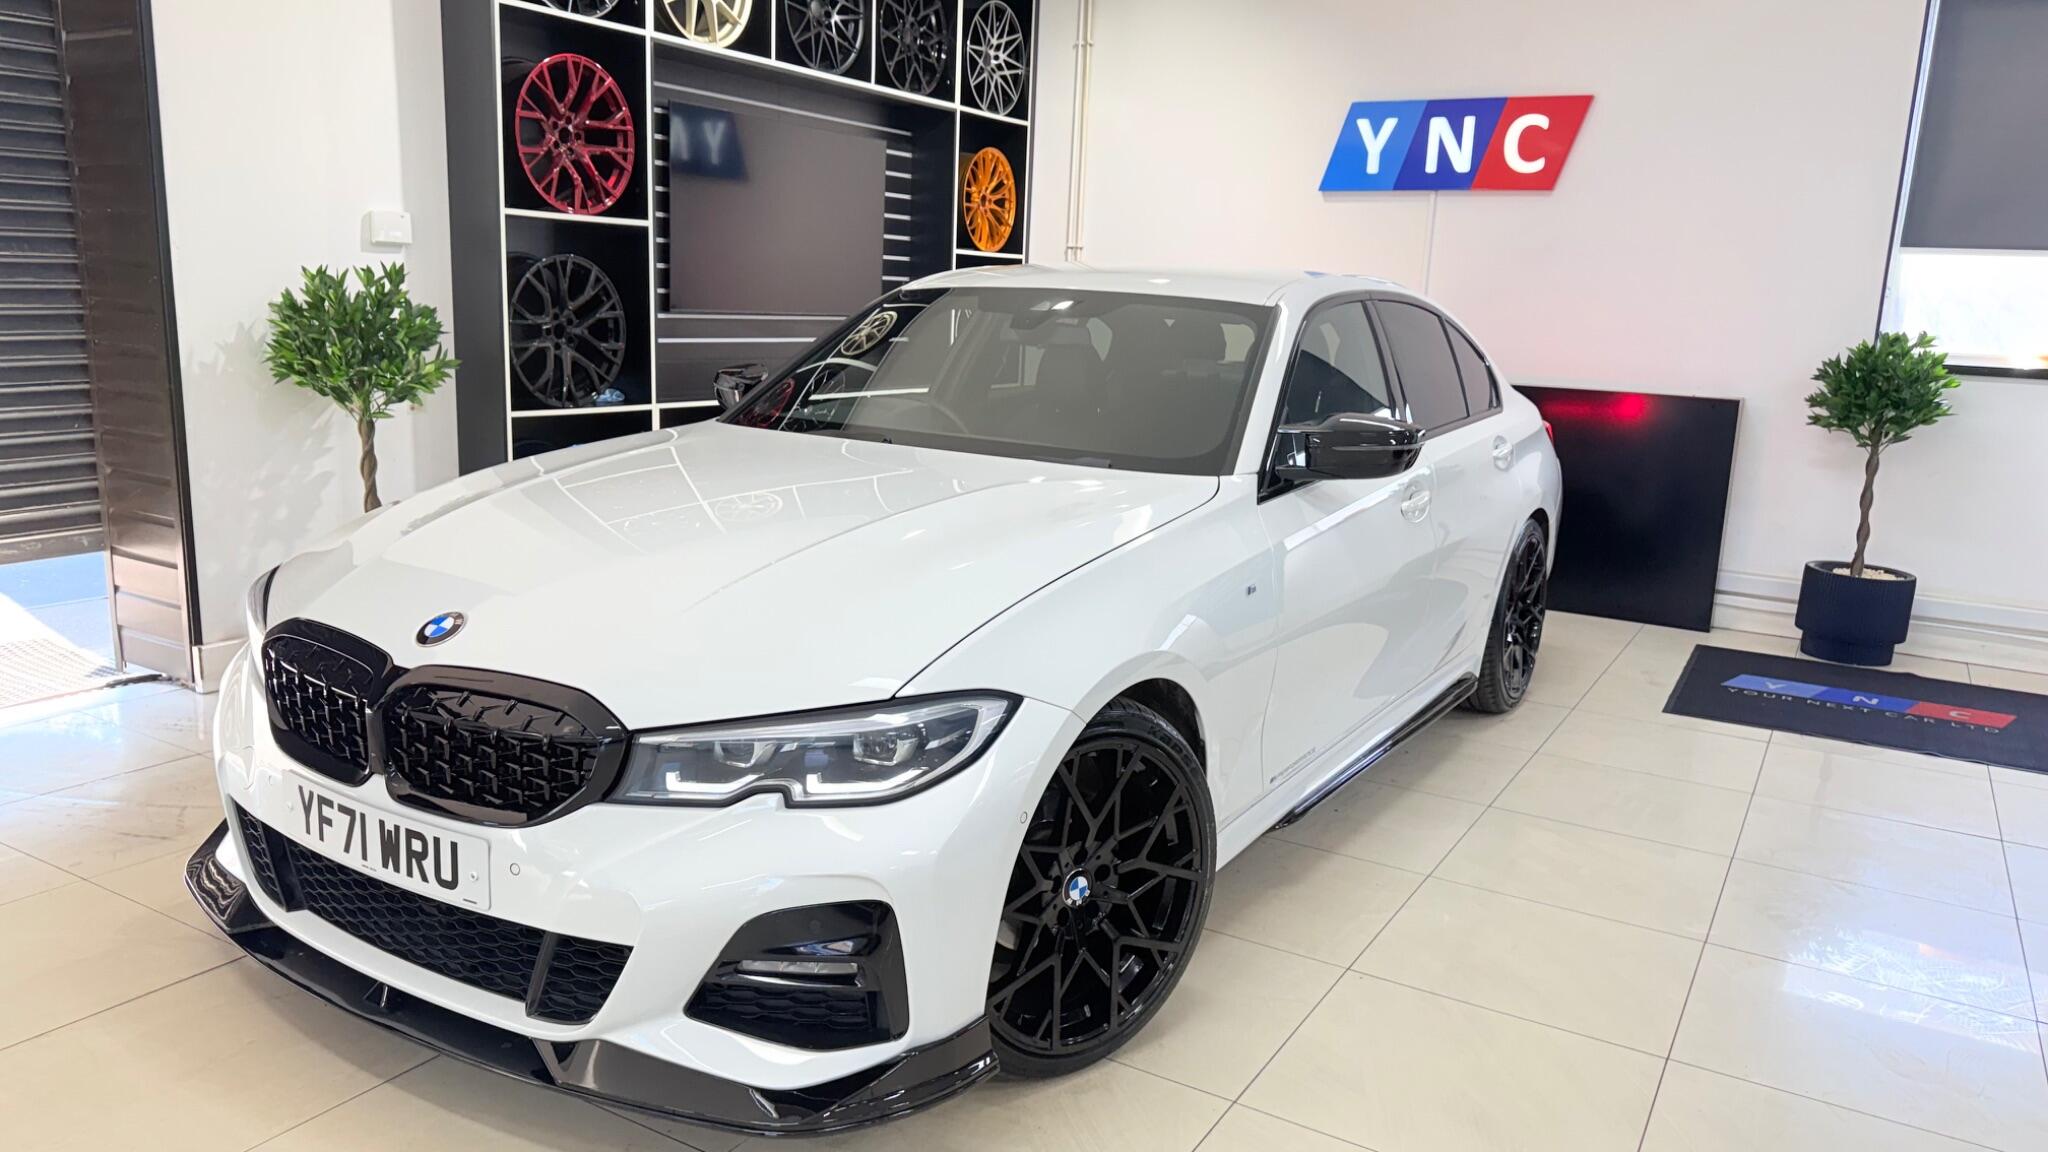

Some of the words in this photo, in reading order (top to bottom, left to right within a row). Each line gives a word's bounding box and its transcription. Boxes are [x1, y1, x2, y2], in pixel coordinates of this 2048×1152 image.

[1355, 112, 1550, 175] YNC
[1728, 687, 1793, 701] YOUR
[1806, 699, 1871, 713] NEXT
[1884, 711, 1935, 724] CAR
[1765, 681, 1972, 720] YNC
[298, 784, 368, 862] YF71
[378, 818, 459, 890] WRU
